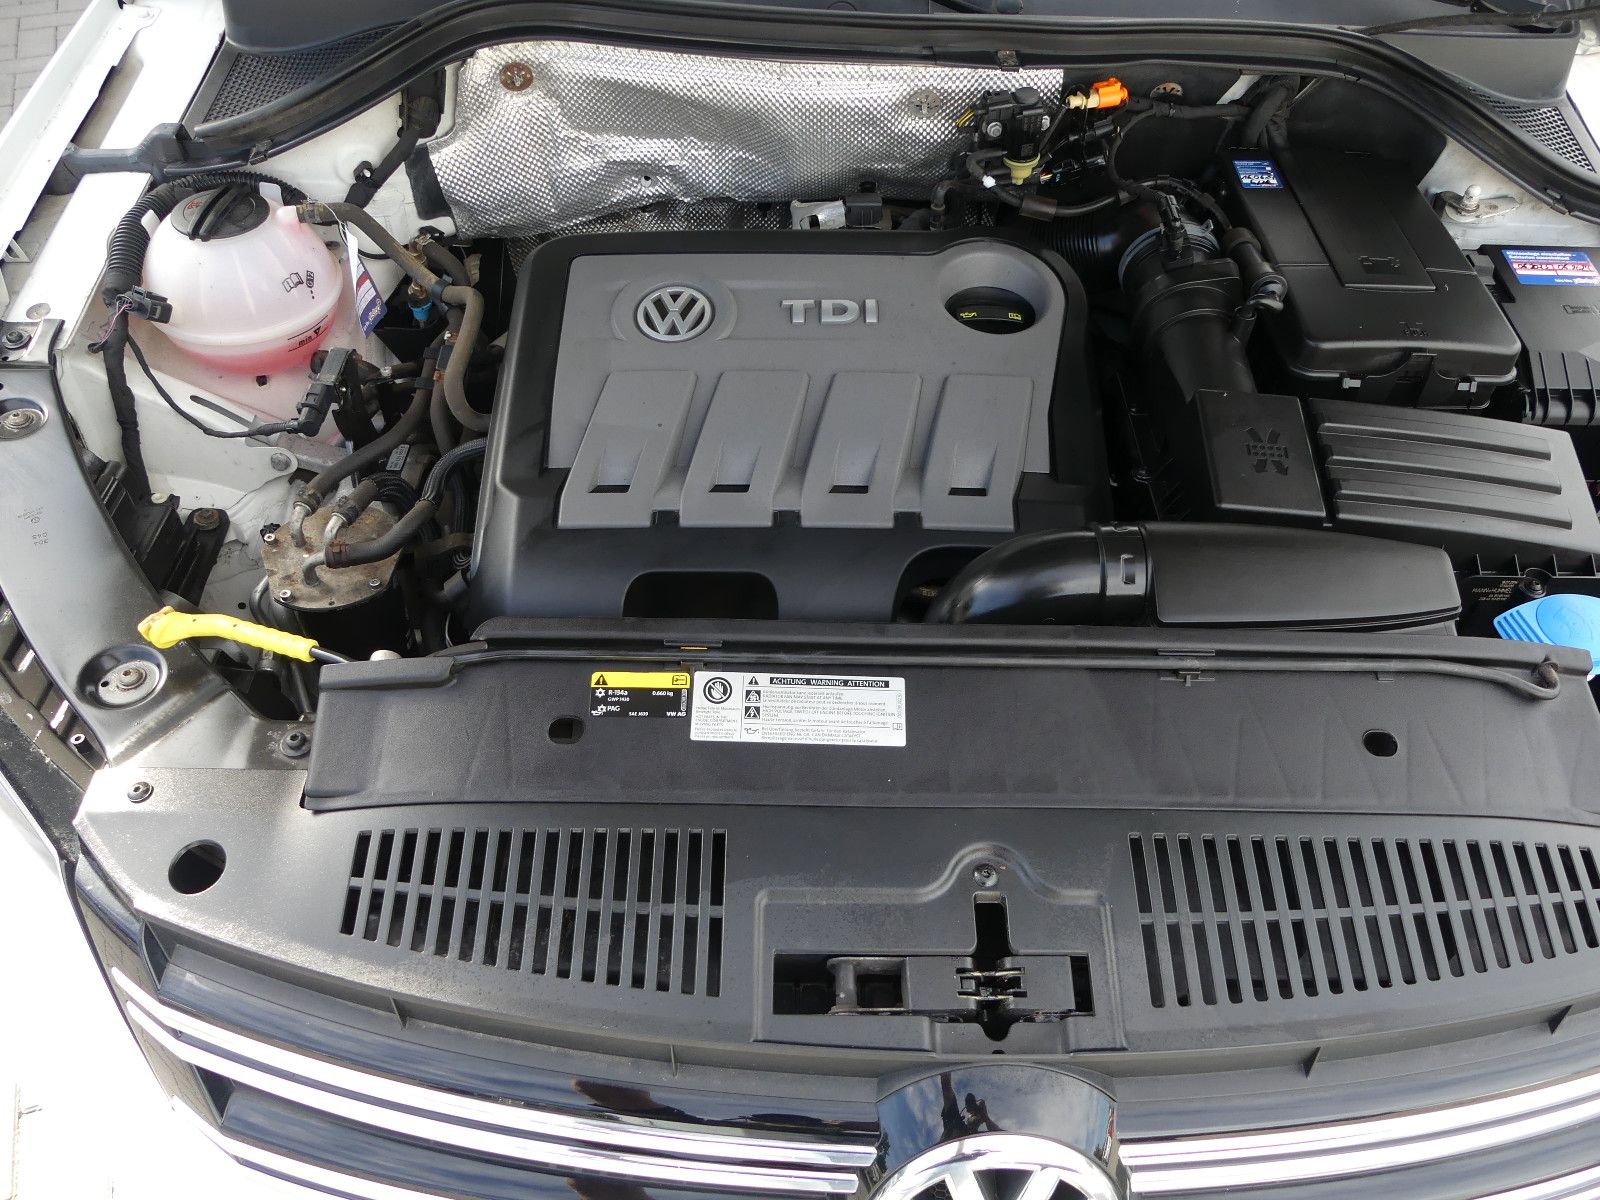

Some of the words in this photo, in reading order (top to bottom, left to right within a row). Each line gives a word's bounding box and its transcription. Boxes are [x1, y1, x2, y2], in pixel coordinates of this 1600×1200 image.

[636, 286, 712, 341] VW
[782, 299, 878, 324] TDI
[298, 335, 313, 348] min
[810, 679, 844, 687] WARNING
[847, 680, 885, 688] ATTENTION
